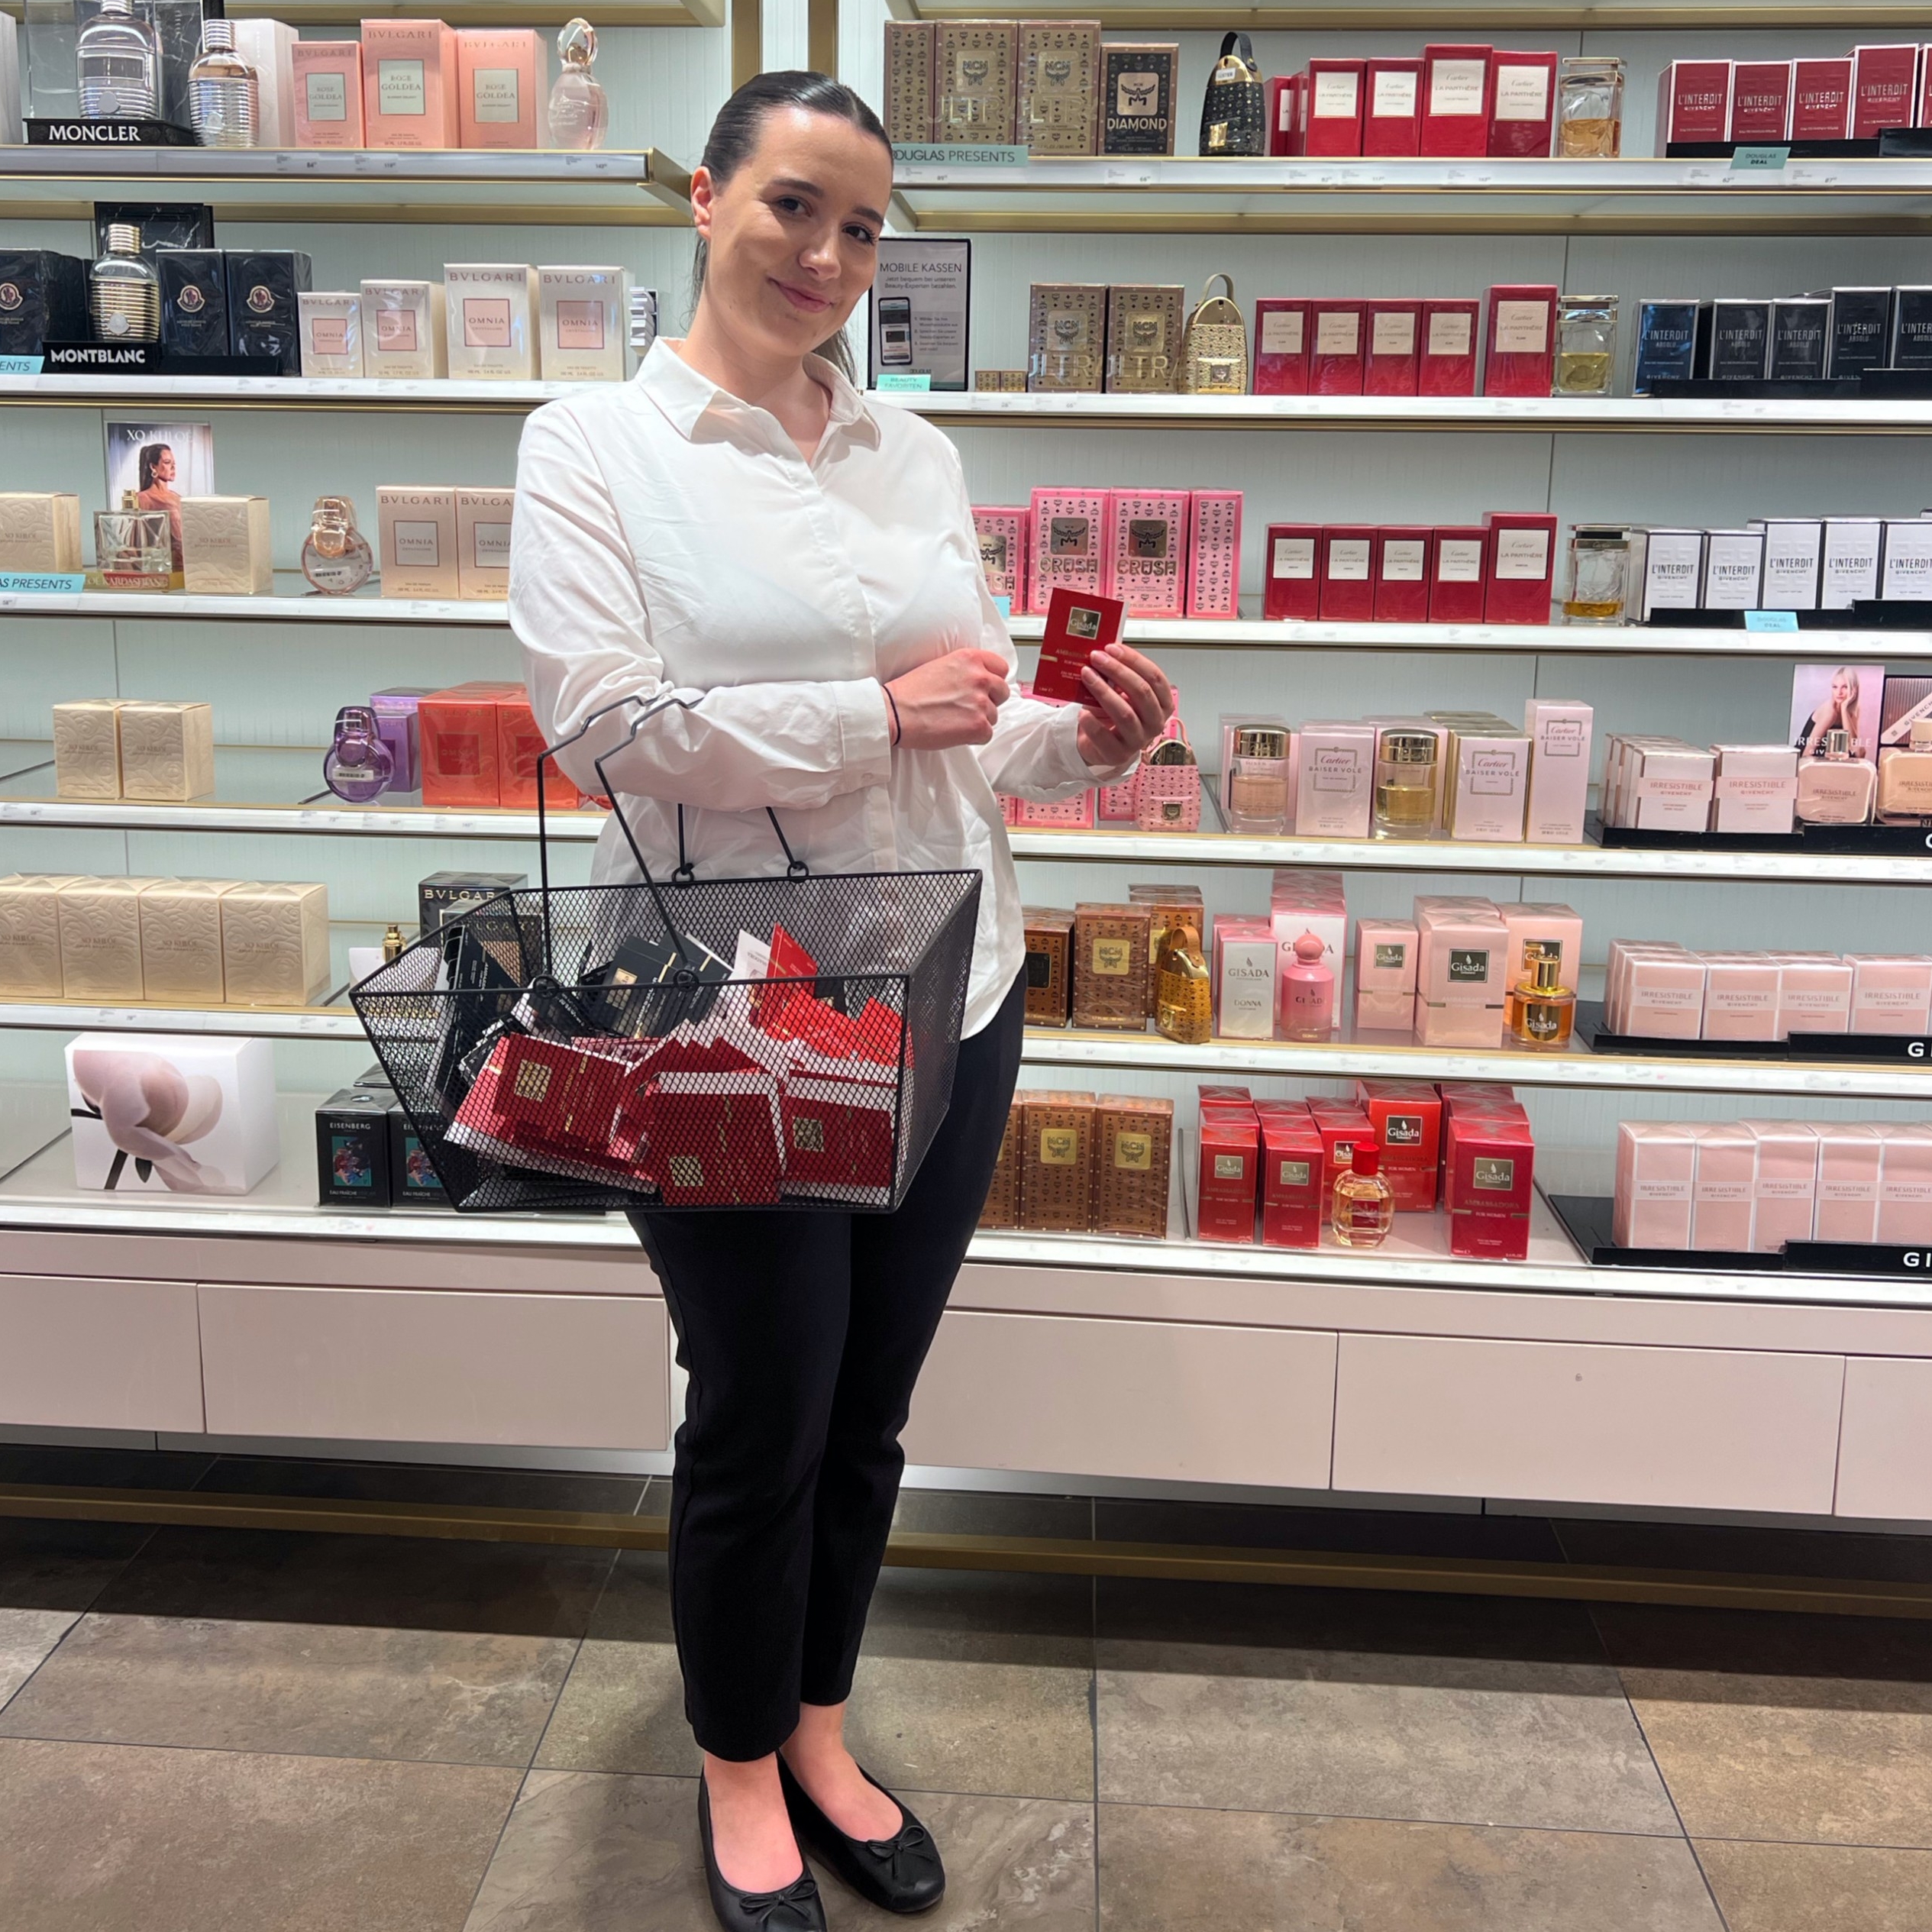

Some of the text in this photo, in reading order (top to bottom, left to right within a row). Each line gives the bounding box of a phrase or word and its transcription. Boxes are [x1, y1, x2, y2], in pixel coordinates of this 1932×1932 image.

[1861, 84, 1908, 97] L'INTERDIT
[1678, 93, 1723, 105] L'INTERDIT
[1738, 95, 1782, 107] L'INTERDIT
[1799, 92, 1844, 104] L'INTERDIT
[1107, 118, 1168, 131] DIAMOND
[49, 125, 141, 141] MONCLER
[948, 151, 1016, 163] PRESENTS
[880, 263, 962, 273] MOBILE KASSEN
[449, 273, 522, 282] BVLGARI
[543, 274, 615, 283] BVLGARI
[1055, 320, 1080, 330] MCM
[1133, 321, 1158, 331] MCM
[1837, 323, 1882, 334] L'INTERDIT
[1901, 322, 1932, 334] L'INTER
[1645, 329, 1688, 341] L'INTERDIT
[1720, 329, 1762, 341] L'INTERDIT
[1778, 329, 1821, 341] L'INTERDIT
[50, 348, 146, 364] MONTBLANC
[0, 361, 31, 372] ENTS
[127, 429, 146, 442] XO
[381, 496, 450, 505] BVLGARI
[461, 497, 512, 506] BVLGA
[1039, 557, 1098, 573] CRUSH
[1117, 559, 1177, 577] CRUSH
[1769, 557, 1814, 570] L'INTERDIT
[1829, 557, 1873, 569] L'INTERDIT
[1653, 564, 1695, 576] L'INTERDIT
[1713, 564, 1756, 577] L'INTERDIT
[11, 577, 72, 590] PRESENTS
[1070, 618, 1097, 631] Gisada
[1550, 725, 1577, 734] Cartier
[1795, 736, 1872, 748] IRRESBLE
[1320, 754, 1352, 764] Cartier
[1478, 758, 1508, 768] Cartier
[1650, 782, 1703, 791] IRRESISTIBLE
[1729, 780, 1787, 789] IRRESISTIBLE
[424, 890, 497, 900] BVLGAR
[1377, 953, 1403, 962] Gisada
[1228, 968, 1270, 977] GISADA
[1452, 962, 1485, 972] Gisada
[1641, 991, 1693, 1000] IRRESISTIBLE
[1717, 994, 1769, 1003] IRRESISTIBLE
[1788, 993, 1840, 1003] IRRESISTIBLE
[1865, 992, 1921, 1001] IRRESISTIBLE
[1526, 1018, 1557, 1030] Gisada
[330, 1122, 371, 1130] EISENBERG
[1388, 1127, 1420, 1139] Gisada
[1048, 1136, 1071, 1146] MCM
[1121, 1140, 1145, 1151] MCM
[1216, 1164, 1241, 1173] Gisada
[1282, 1171, 1307, 1179] Gisada
[1475, 1171, 1510, 1181] Gisada
[1825, 1185, 1871, 1194] IRRESISTIBLE
